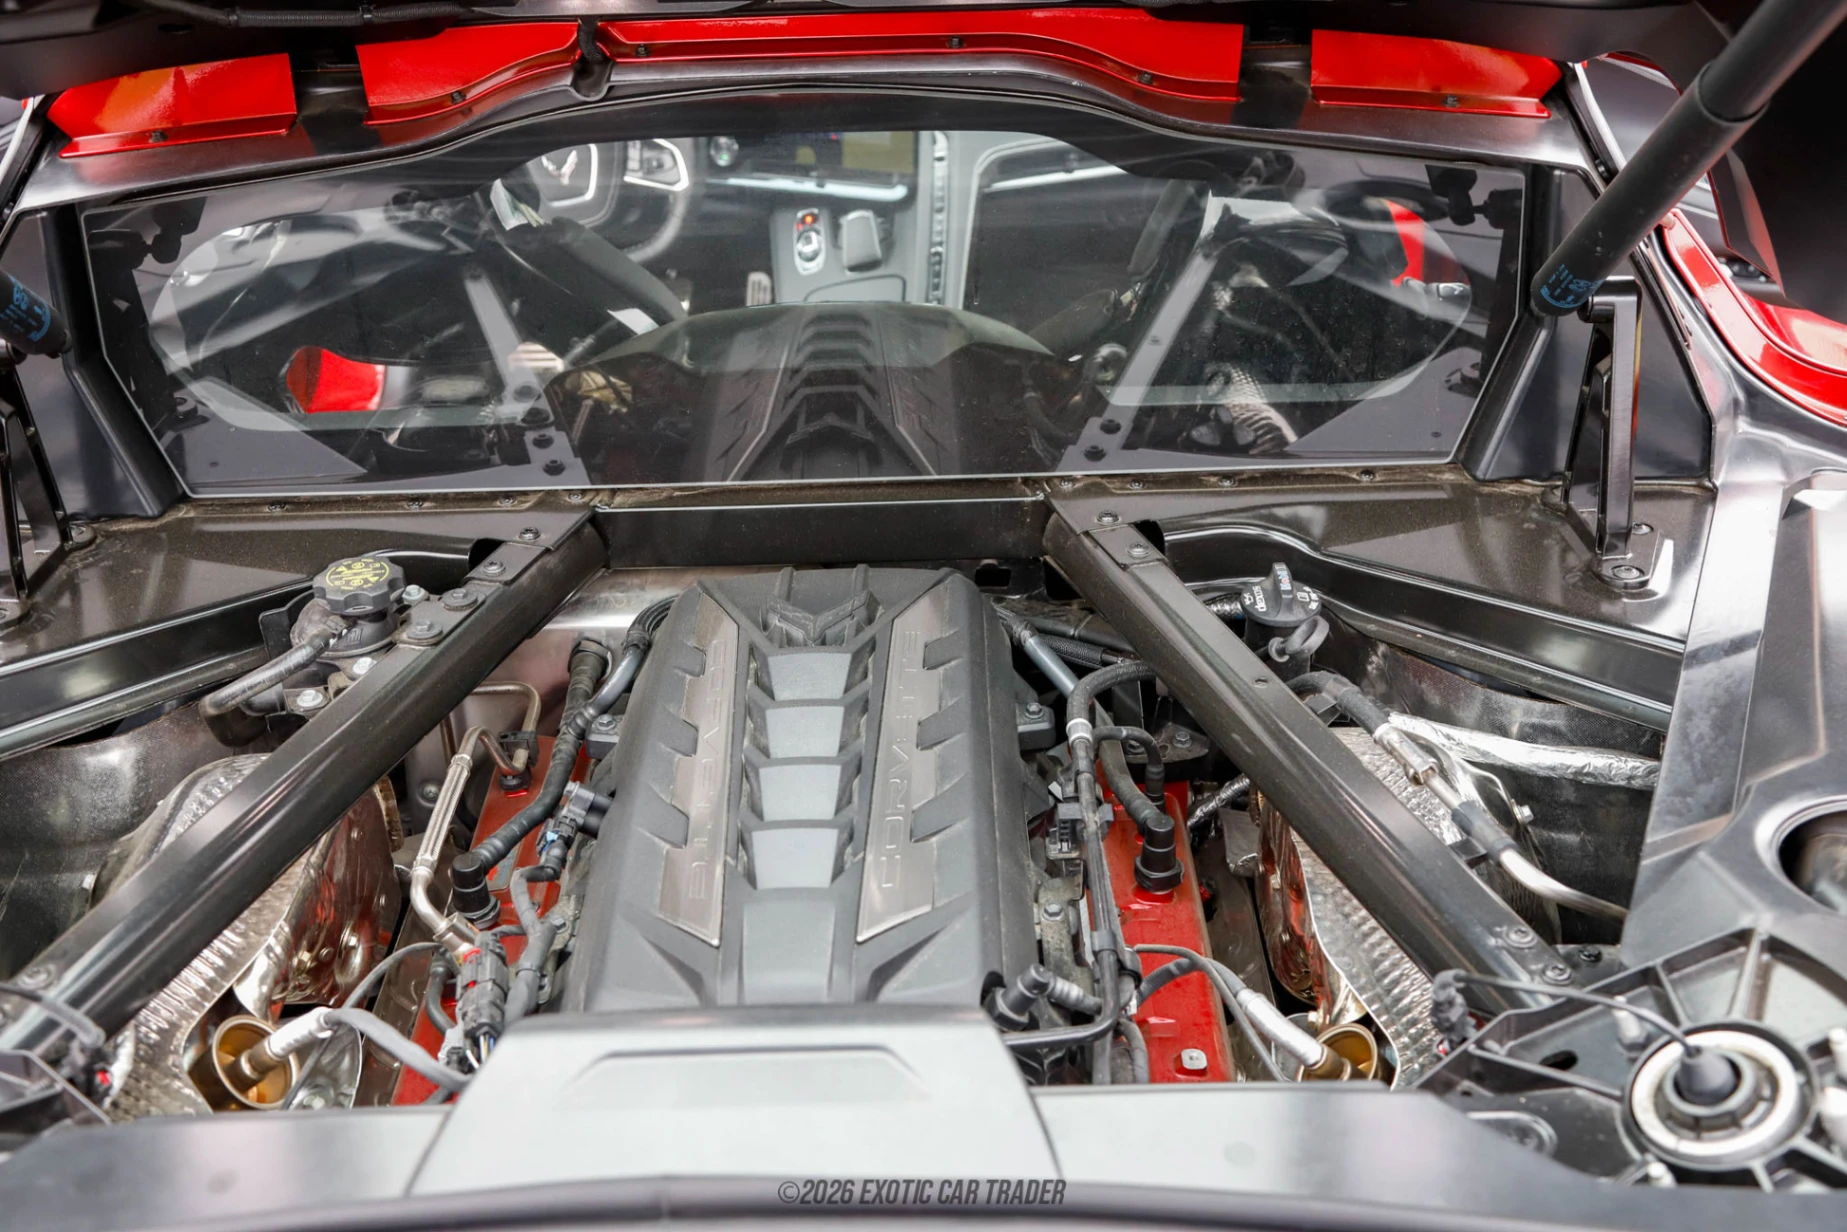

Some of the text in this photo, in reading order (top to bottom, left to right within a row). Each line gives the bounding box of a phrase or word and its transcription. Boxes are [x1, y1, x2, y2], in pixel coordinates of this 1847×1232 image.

[1252, 586, 1266, 612] dexos
[689, 639, 727, 899] CORVETTE
[880, 631, 921, 888] CORVETTE
